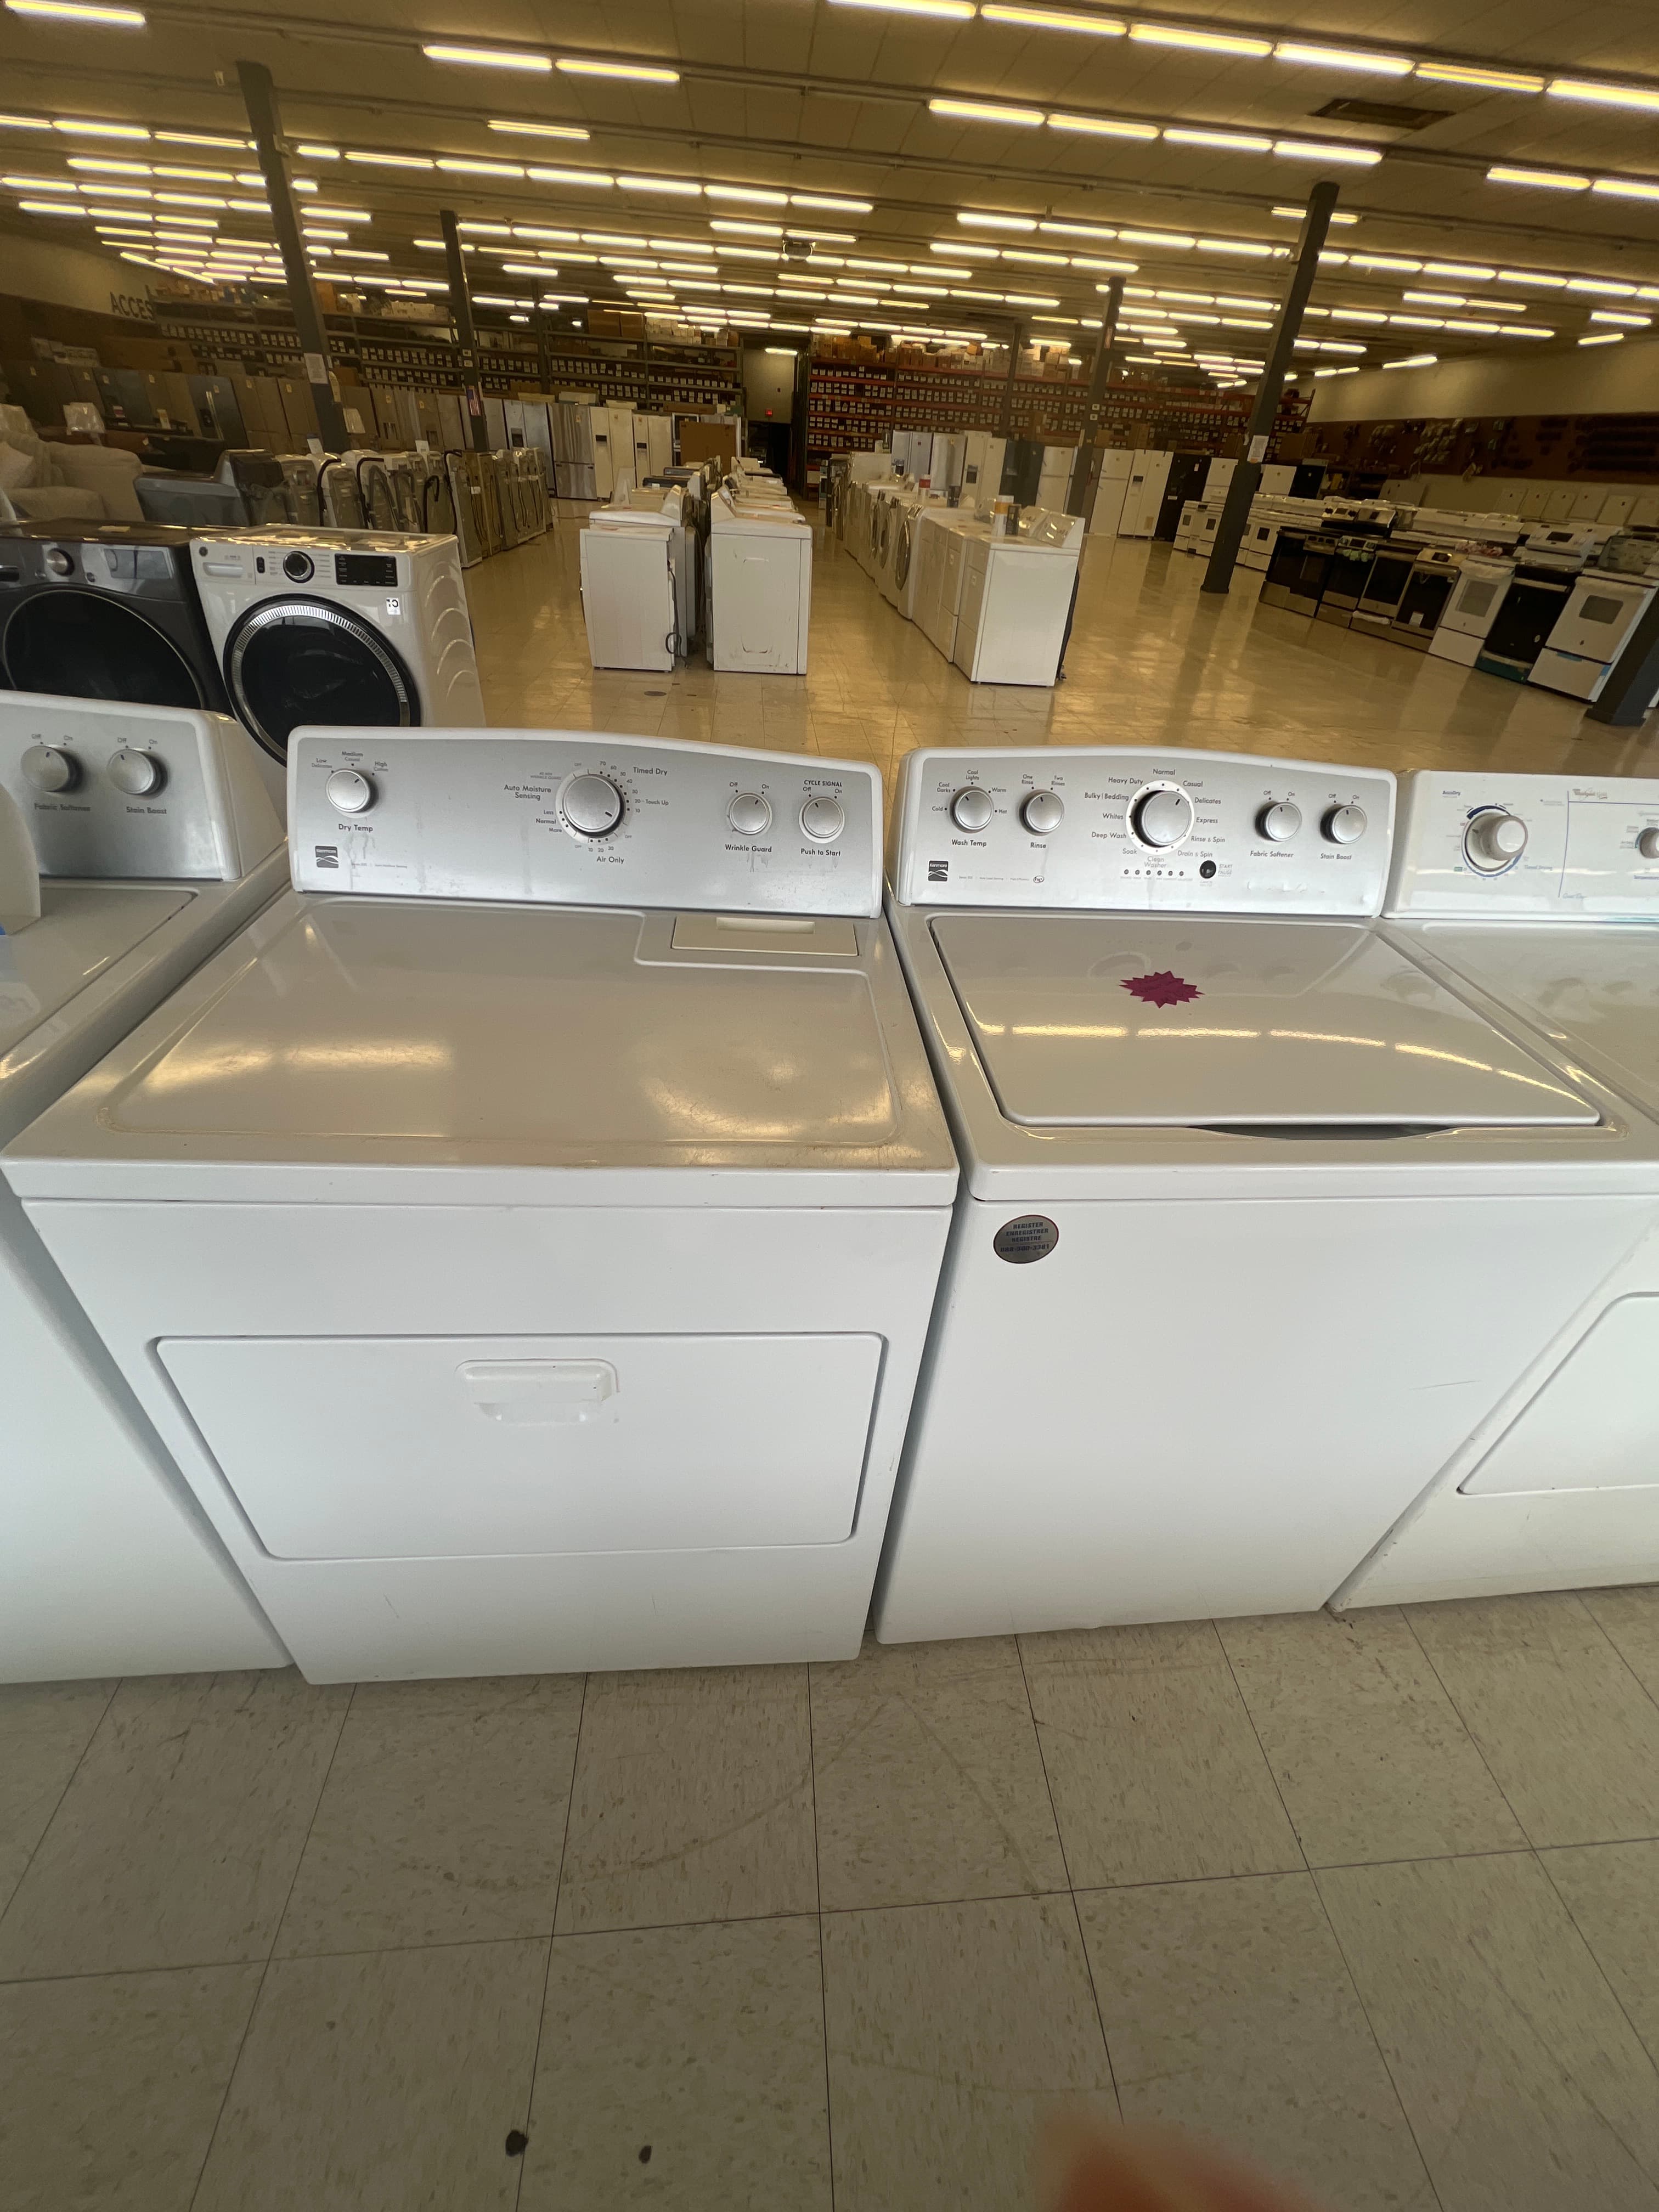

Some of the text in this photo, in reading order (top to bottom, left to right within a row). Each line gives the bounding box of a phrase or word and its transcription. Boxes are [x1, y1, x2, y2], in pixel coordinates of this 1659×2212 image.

[515, 792, 540, 801] Sensing
[338, 823, 373, 833] Dry Temp
[1006, 1228, 1048, 1236] ENREGISTRER
